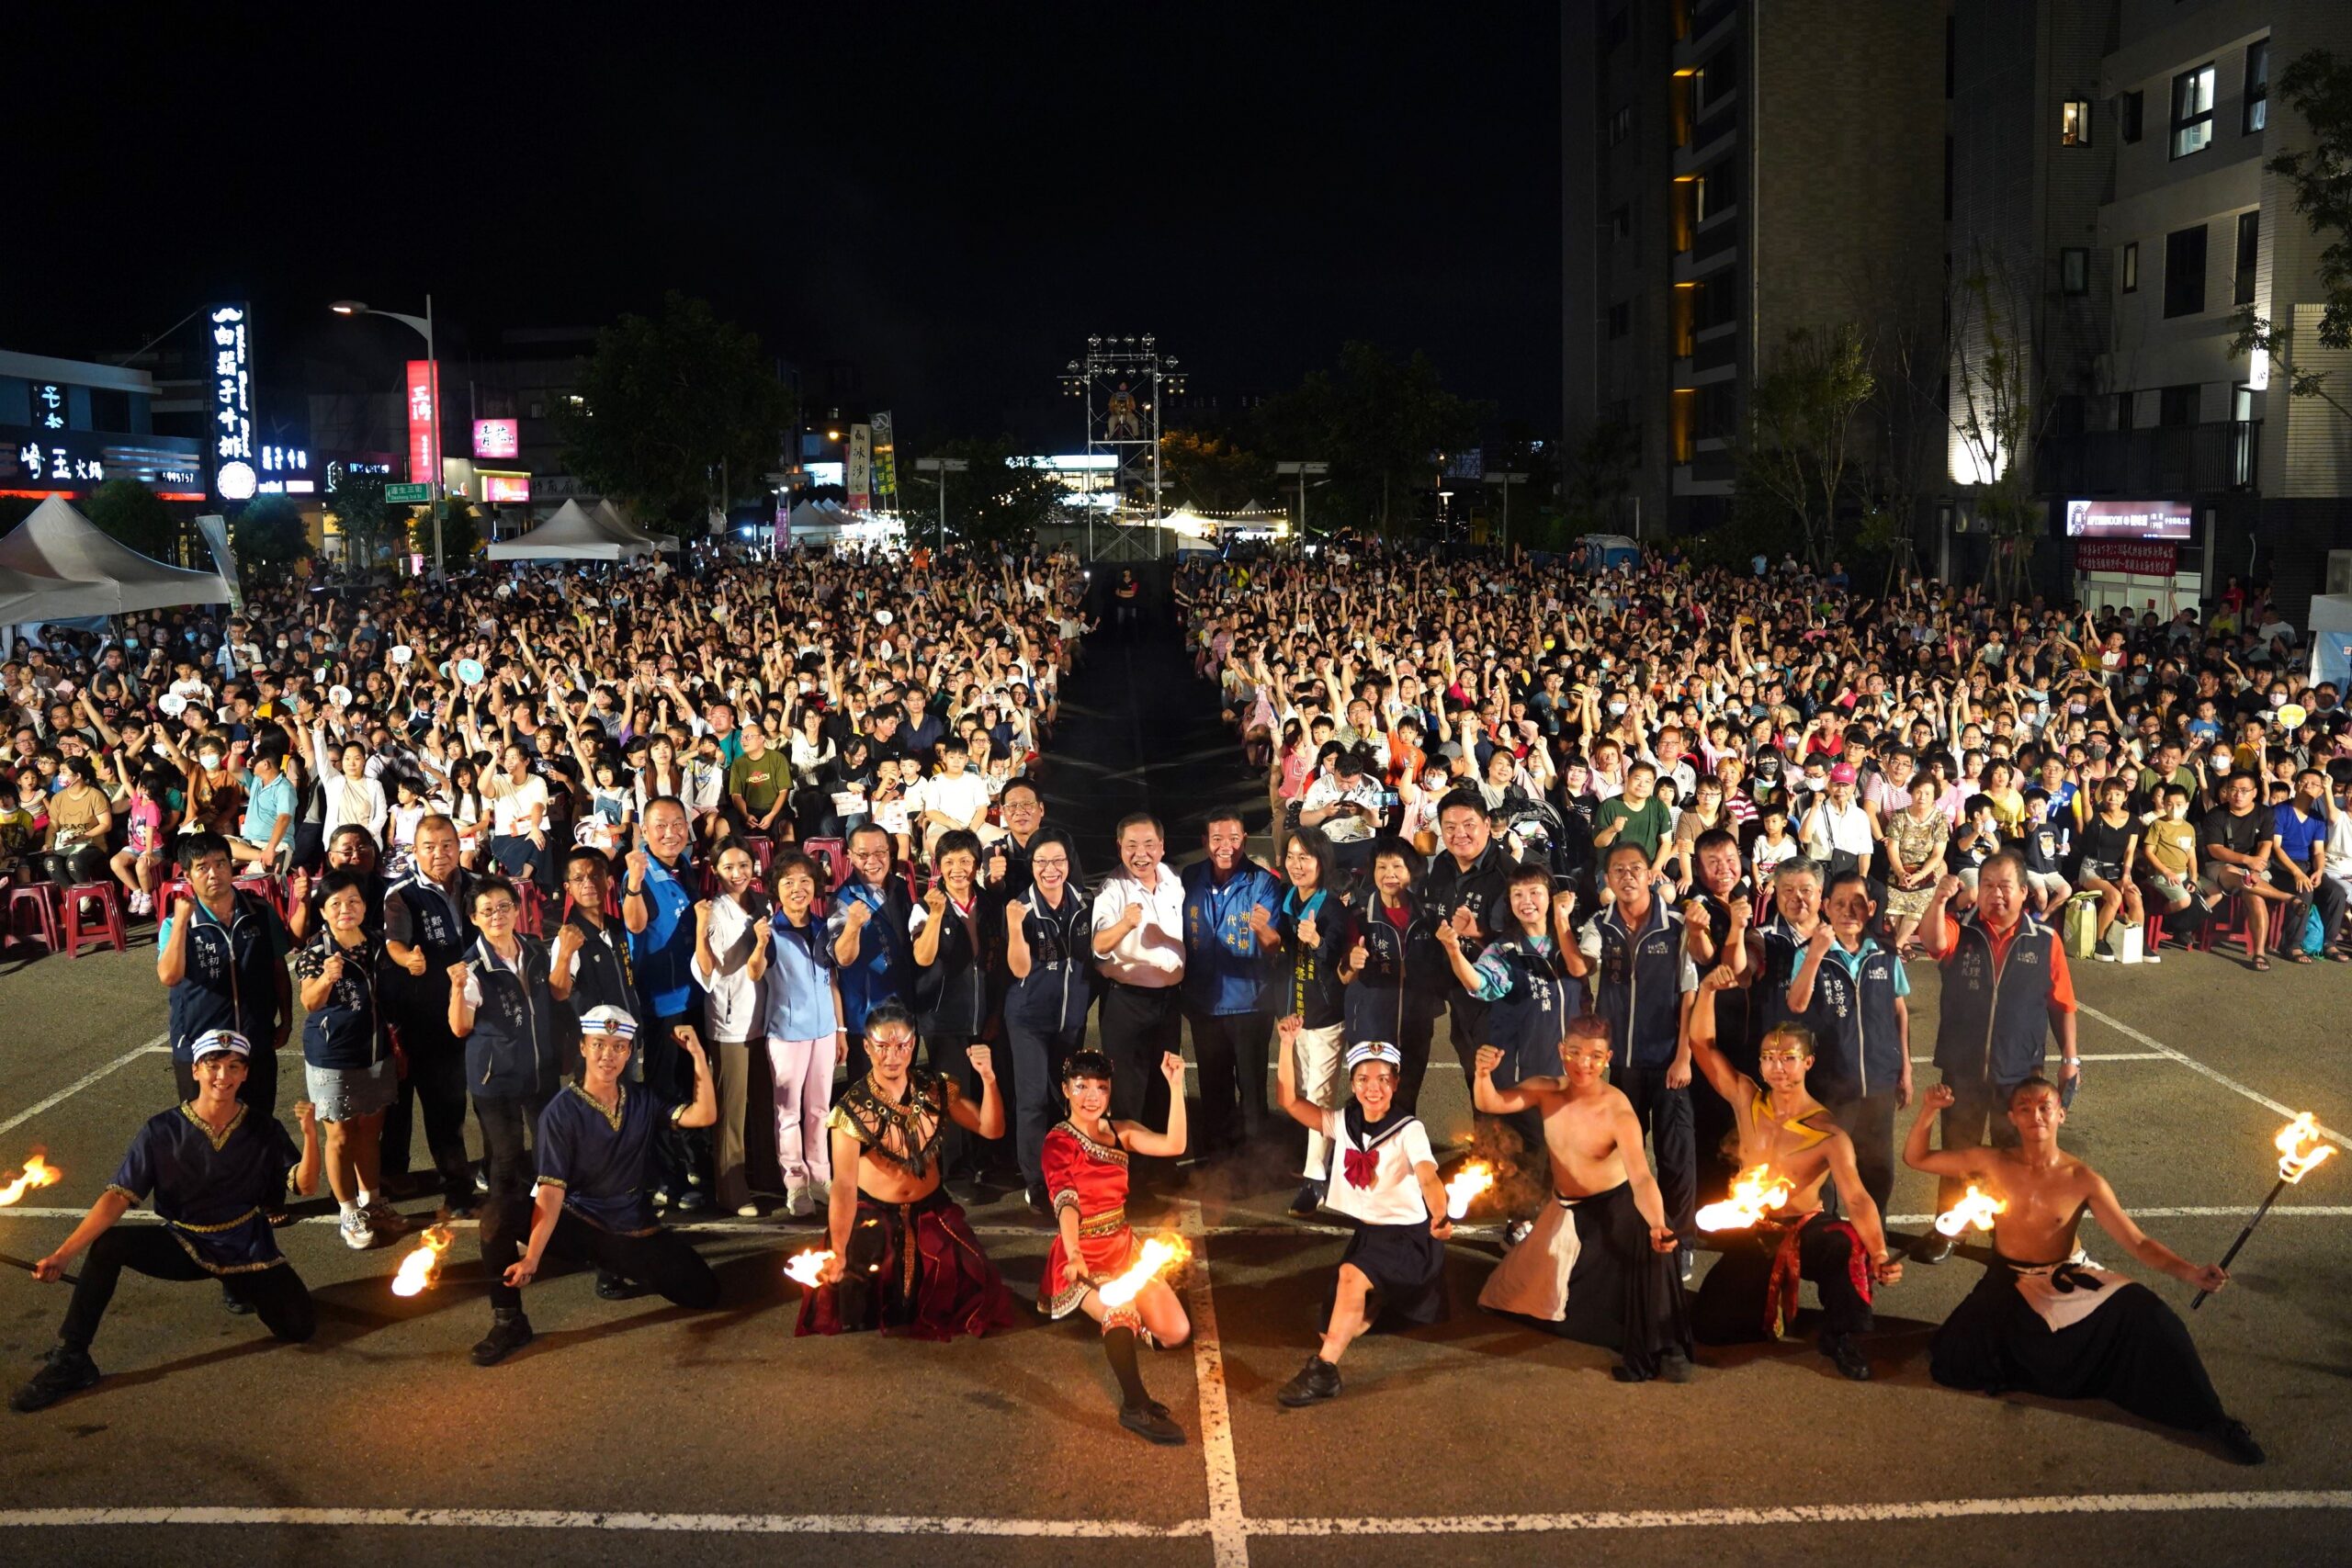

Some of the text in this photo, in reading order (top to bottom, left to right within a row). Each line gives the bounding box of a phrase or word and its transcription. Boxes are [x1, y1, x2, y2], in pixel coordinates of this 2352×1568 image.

[1226, 914, 1237, 945] 代表
[1238, 911, 1251, 951] 湖口鄉
